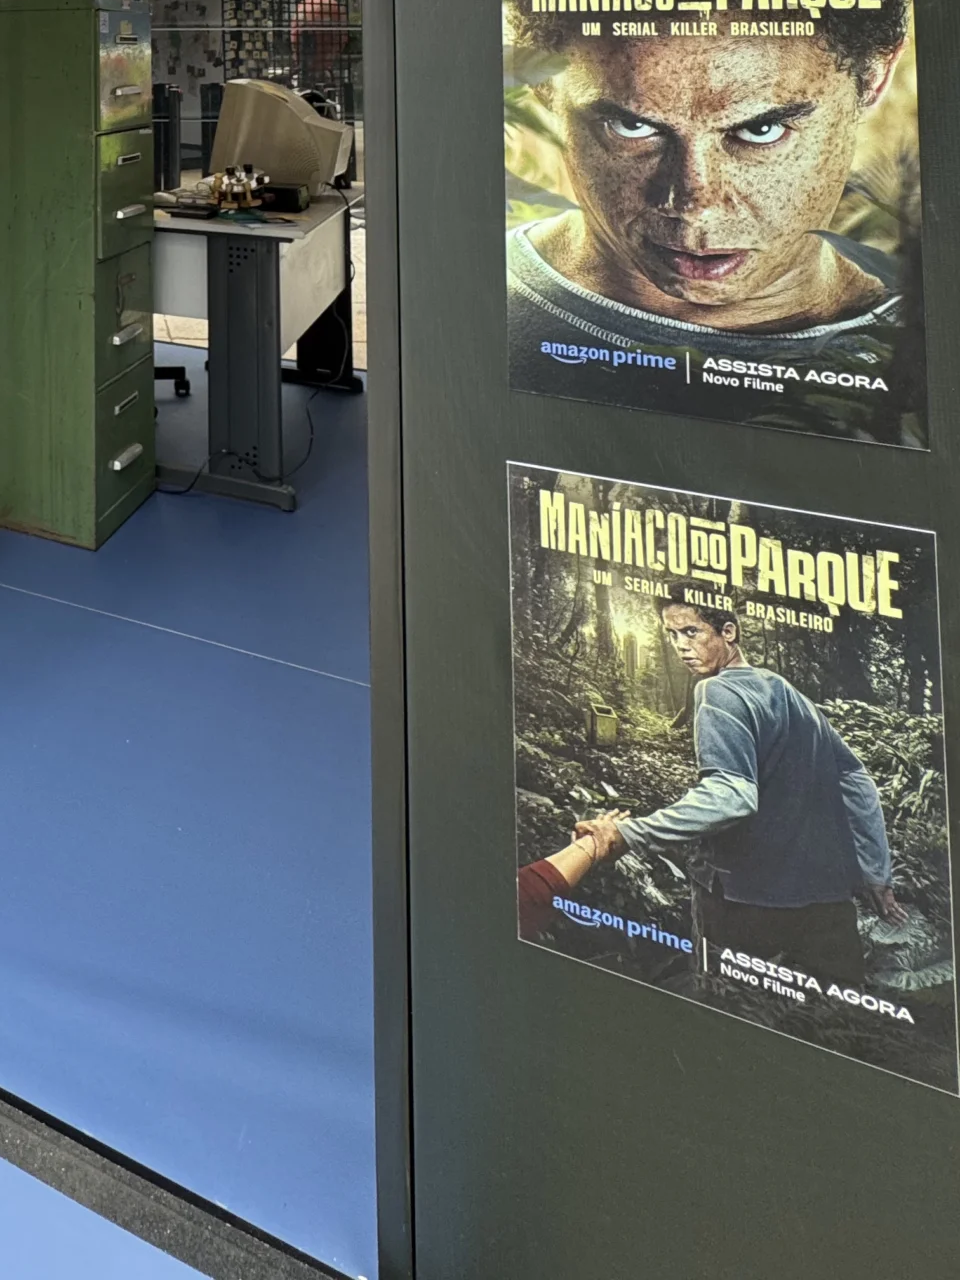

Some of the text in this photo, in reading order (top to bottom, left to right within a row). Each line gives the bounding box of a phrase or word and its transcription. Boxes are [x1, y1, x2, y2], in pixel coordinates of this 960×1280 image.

[582, 21, 815, 36] UM SERIAL KILLER BRASILEIRO
[540, 339, 677, 370] amazon prime
[702, 358, 889, 391] ASSISTA AGORA
[702, 372, 784, 393] Novo Filme
[539, 489, 903, 619] MANÍACO DO PARQUE
[592, 570, 833, 634] UM SERIAL KILLER BRASILEIRO
[552, 895, 693, 953] amazon prime
[720, 962, 805, 1003] Novo Filme
[720, 948, 915, 1024] ASSISTA AGORA
